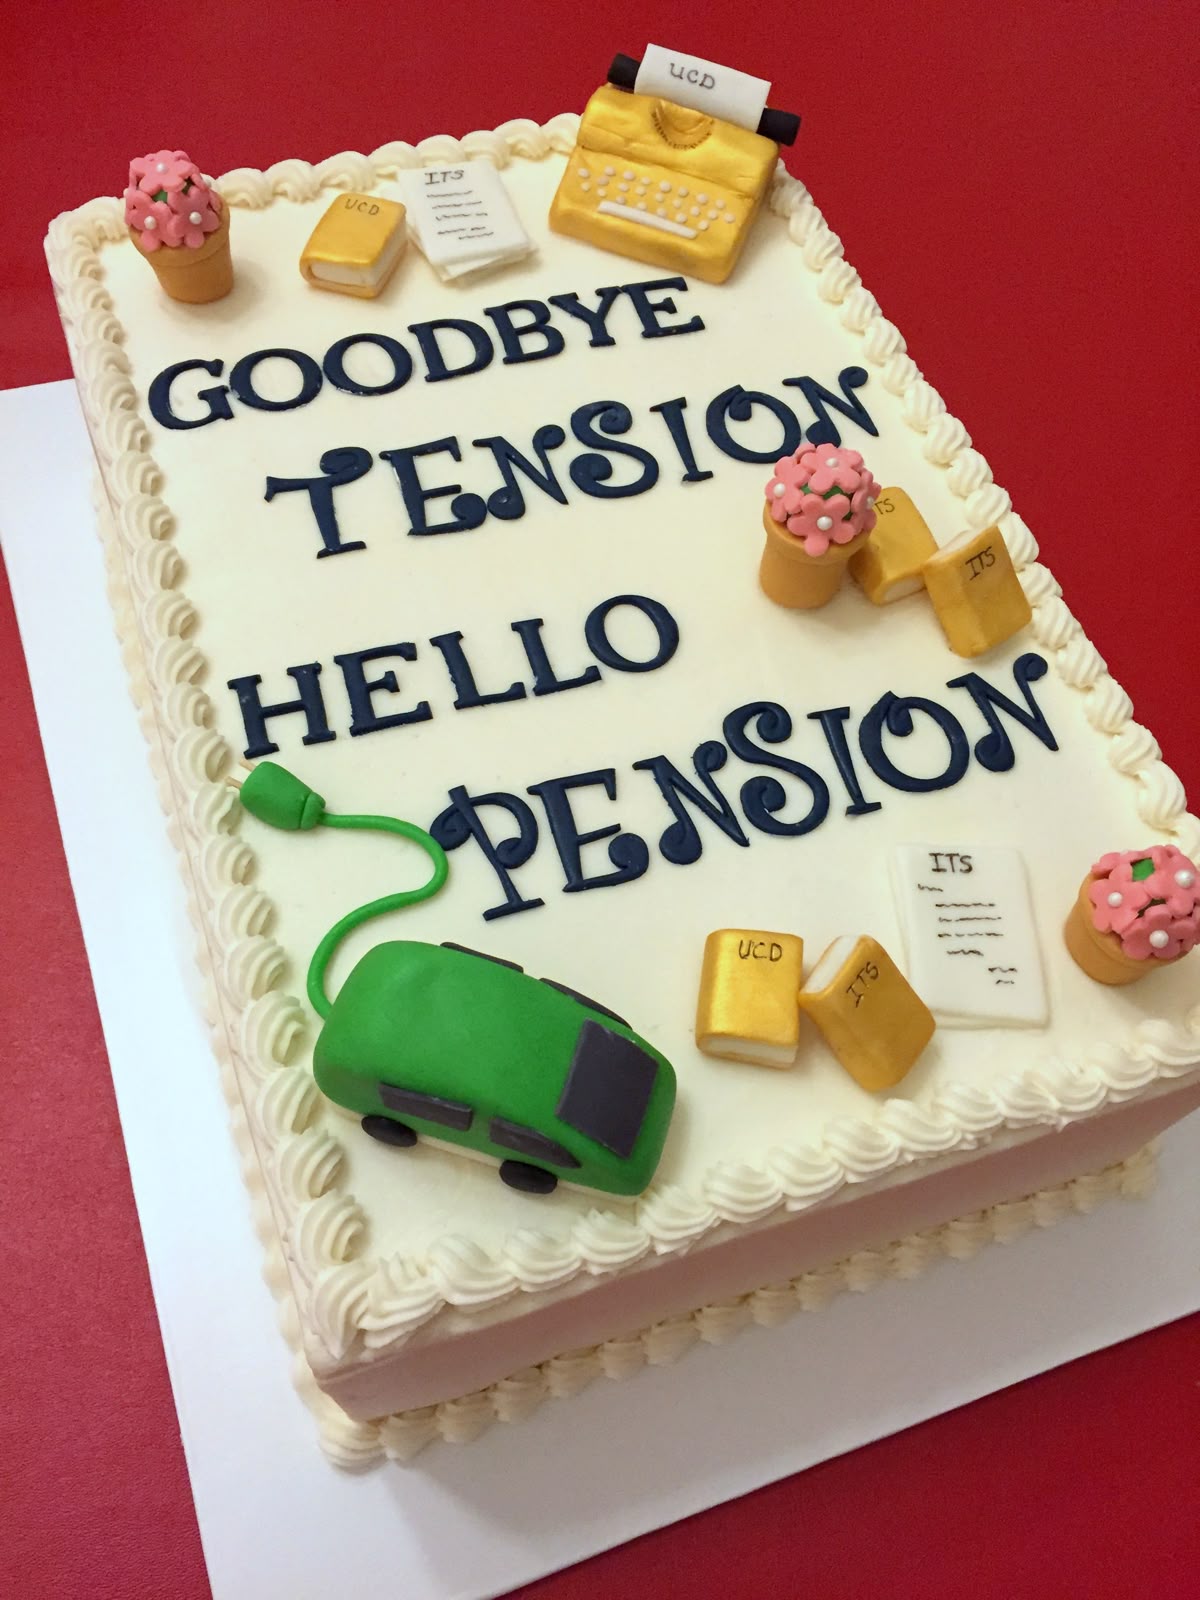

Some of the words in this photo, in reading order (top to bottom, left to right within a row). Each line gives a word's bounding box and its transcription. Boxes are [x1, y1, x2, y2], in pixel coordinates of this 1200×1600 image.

[670, 63, 715, 89] UCD
[425, 169, 464, 185] ITS
[345, 198, 380, 216] UCD
[148, 276, 706, 431] GOODBYE
[263, 366, 879, 559] TENSION
[875, 498, 895, 515] TS
[965, 546, 996, 580] ITS
[227, 594, 680, 760] HELLO
[429, 652, 1059, 922] PENSION
[929, 853, 973, 873] ITS
[739, 939, 782, 961] UCD
[846, 961, 880, 1008] ITS
